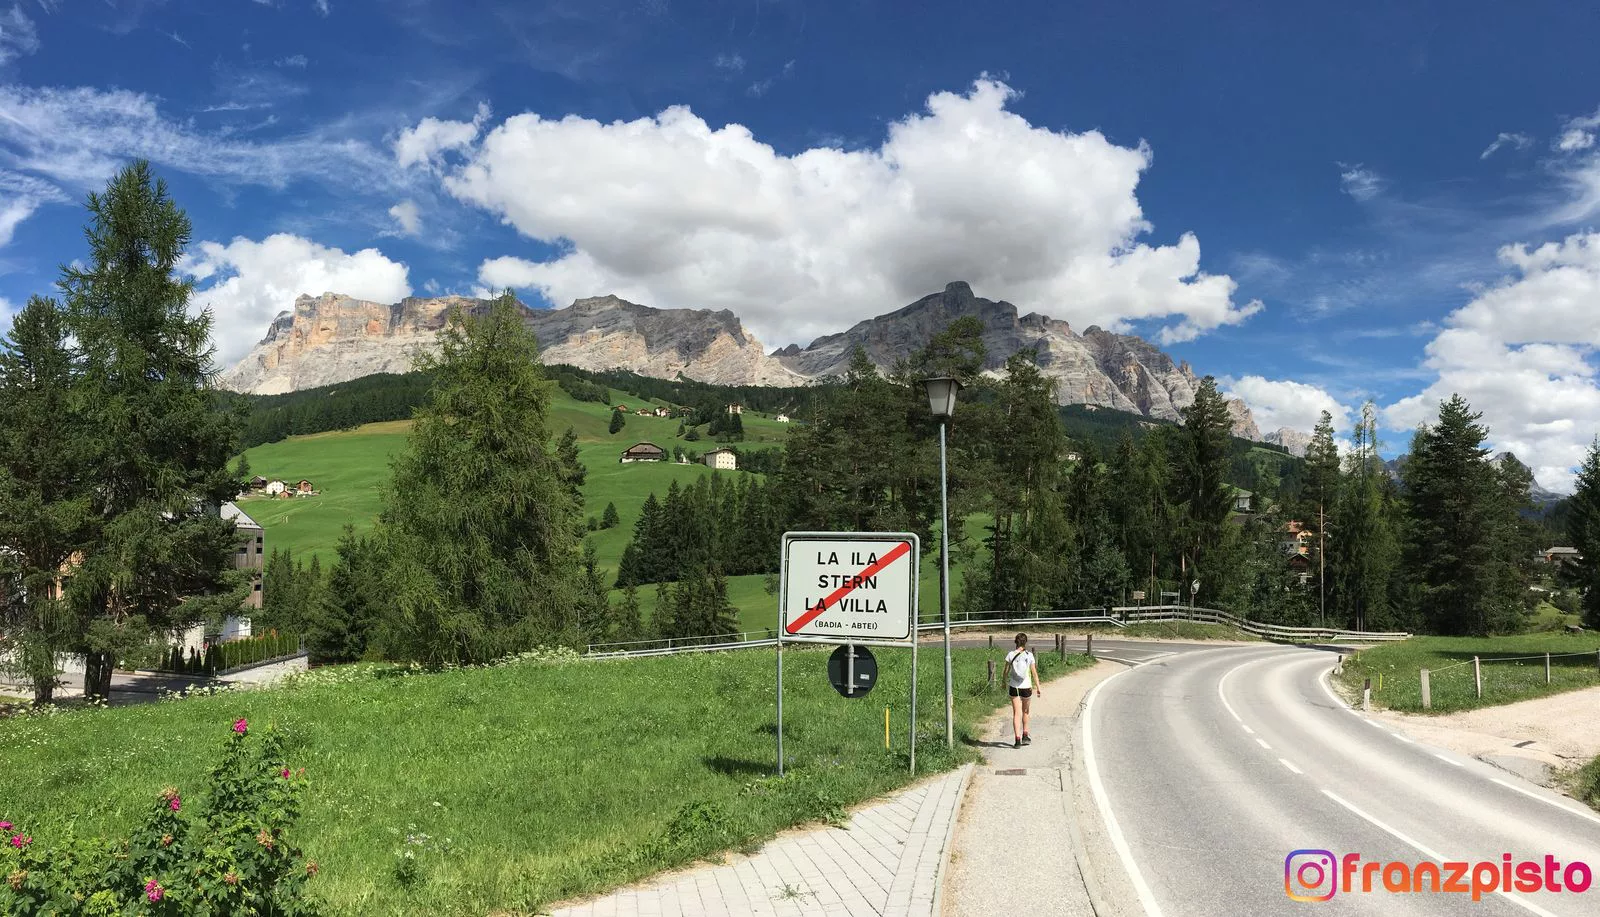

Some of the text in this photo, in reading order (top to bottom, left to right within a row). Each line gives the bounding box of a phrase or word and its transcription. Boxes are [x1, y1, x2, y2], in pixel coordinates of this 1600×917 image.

[817, 552, 878, 566] LA ILA
[817, 575, 877, 589] STERN
[805, 597, 887, 613] LA VILLA
[814, 620, 842, 628] (BADIA
[851, 621, 878, 630] ABTEI)
